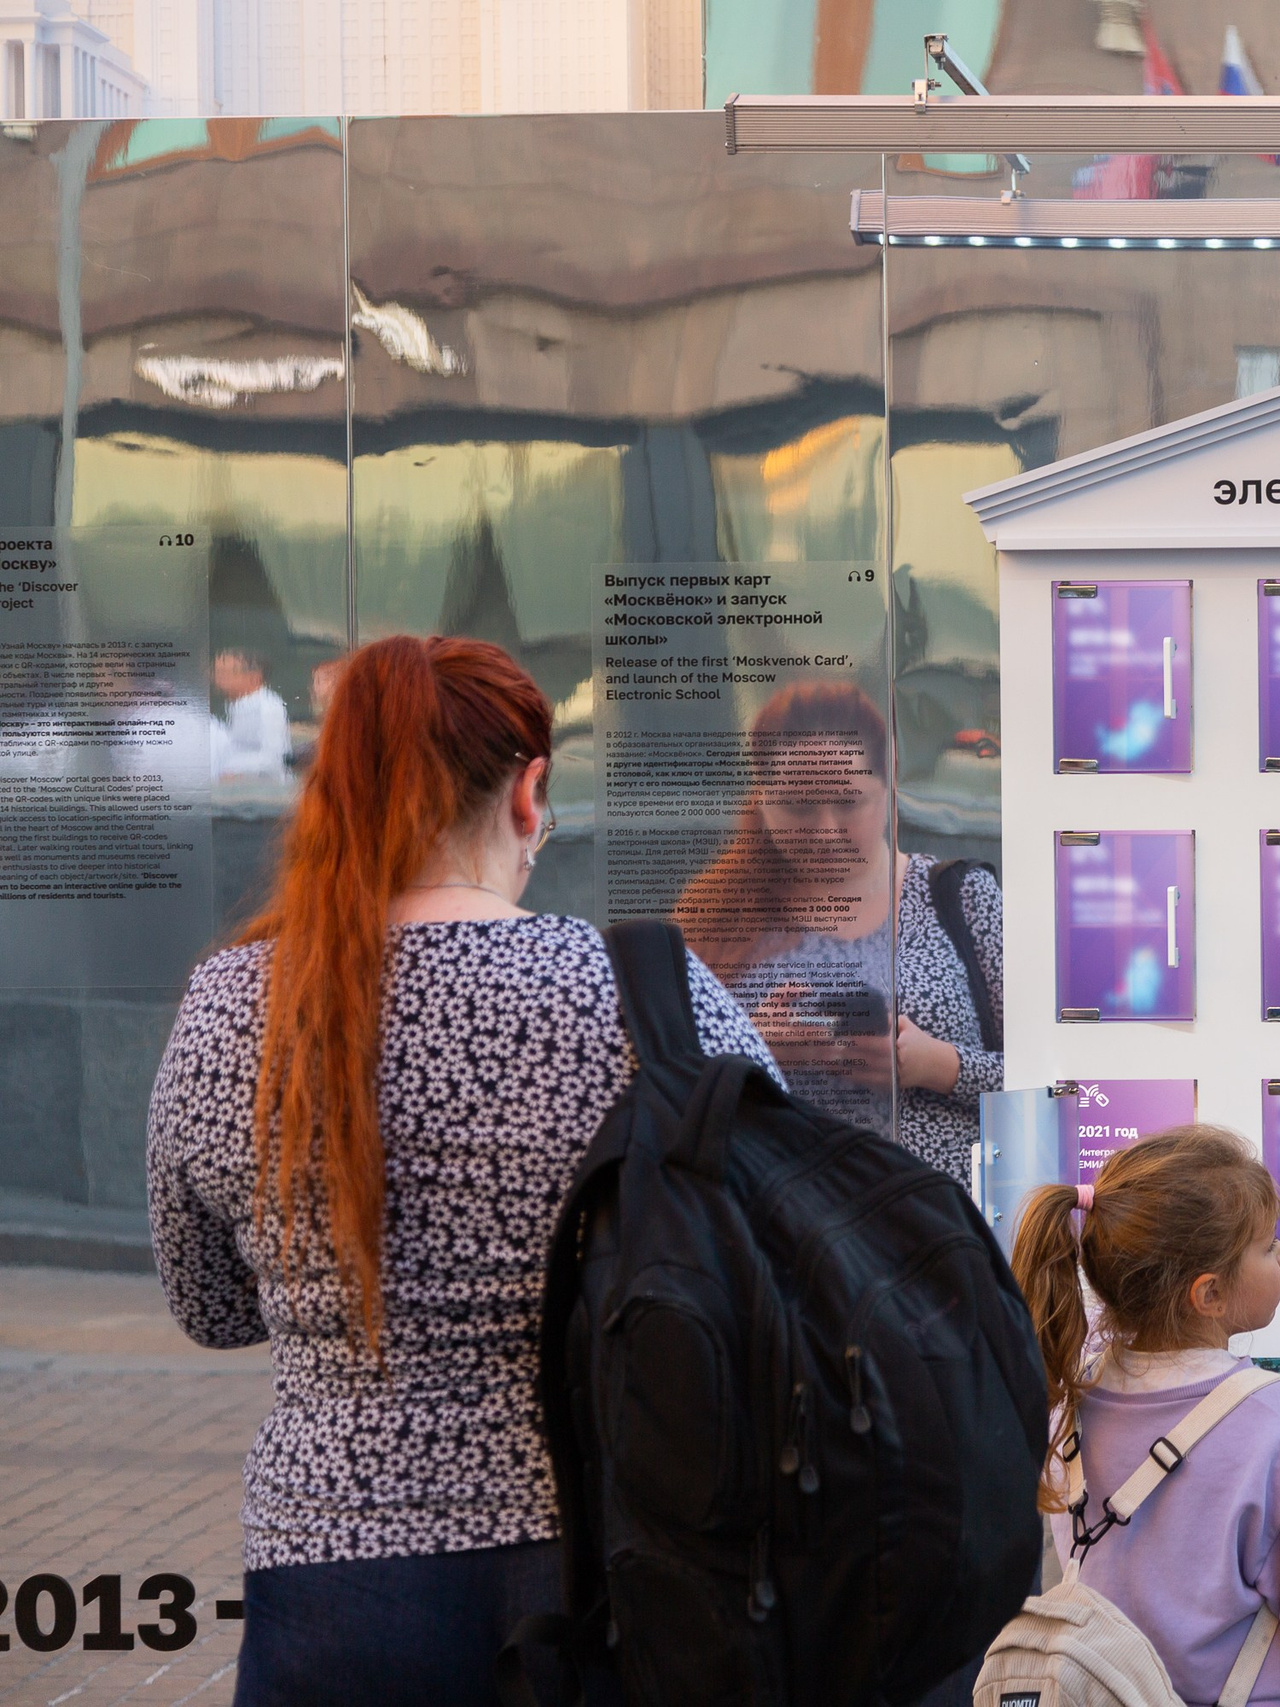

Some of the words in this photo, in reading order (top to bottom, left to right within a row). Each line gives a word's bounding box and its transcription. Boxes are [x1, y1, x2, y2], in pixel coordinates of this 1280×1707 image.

[175, 534, 194, 546] 10
[2, 560, 57, 572] оскву»
[604, 574, 665, 589] Выпуск
[670, 575, 730, 588] первых
[734, 574, 771, 588] карт
[864, 570, 874, 582] 9
[18, 581, 78, 592] ‘Discover
[604, 593, 713, 606] «Москвёнок»
[716, 595, 726, 605] и
[730, 594, 787, 608] запуск
[604, 612, 713, 626] «Московской
[717, 611, 823, 628] электронной
[605, 634, 668, 646] школы»
[606, 656, 657, 668] Release
[660, 656, 674, 667] of
[677, 656, 698, 667] the
[701, 656, 728, 666] first
[732, 655, 810, 666] ‘Moskvenok
[606, 672, 629, 684] and
[633, 672, 677, 684] launch
[680, 672, 694, 683] of
[697, 672, 718, 683] the
[722, 672, 776, 683] Moscow
[606, 688, 672, 700] Electronic
[675, 688, 720, 700] School
[1078, 1125, 1110, 1138] 2021
[1115, 1128, 1138, 1139] год
[0, 1572, 198, 1652] 013
